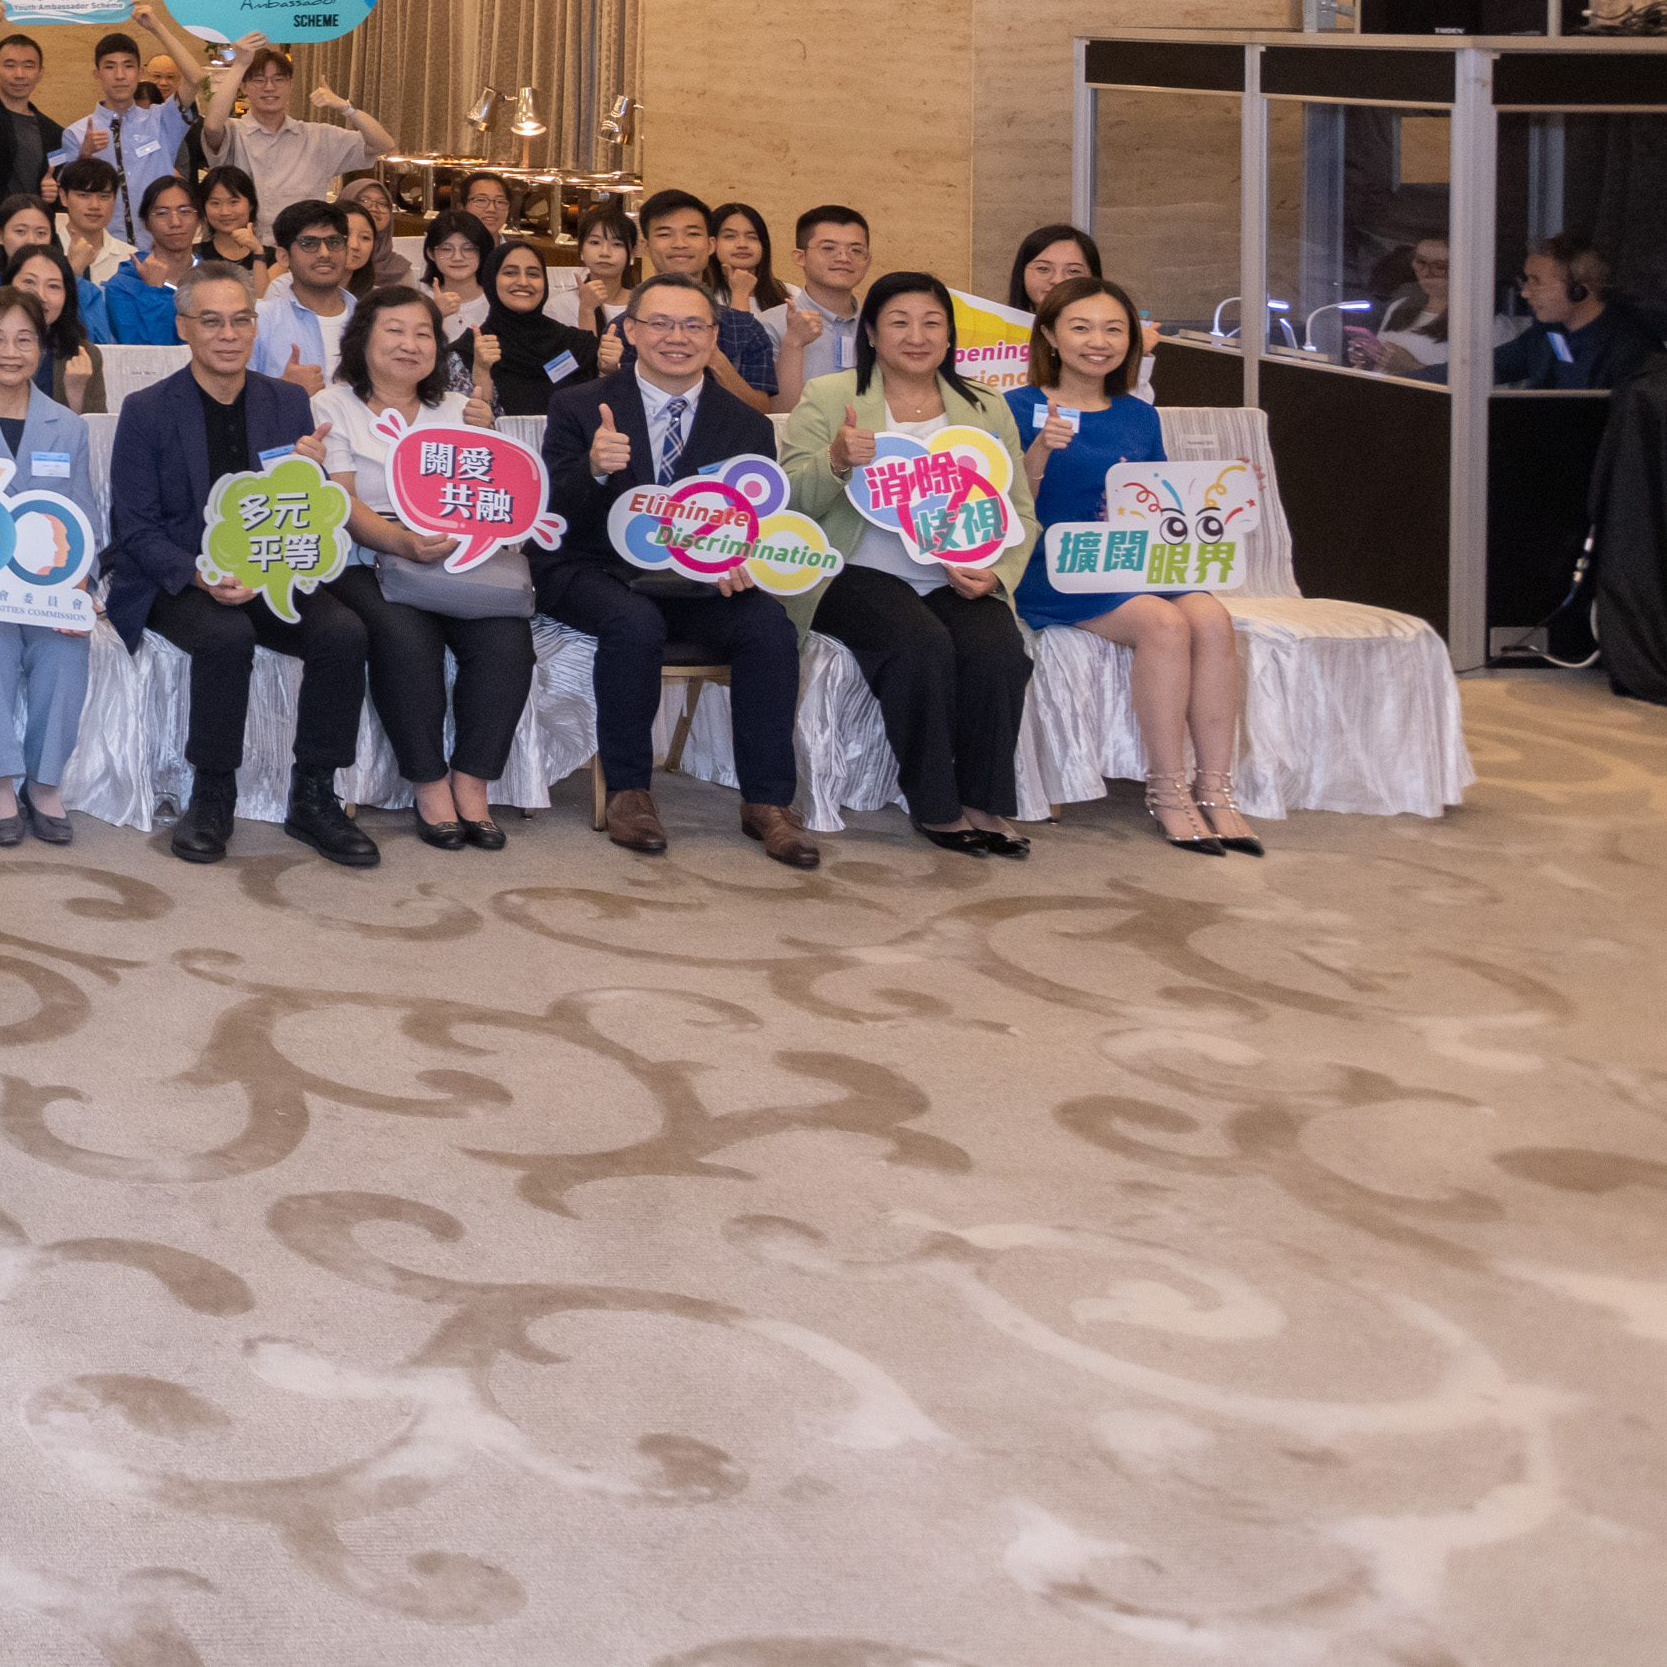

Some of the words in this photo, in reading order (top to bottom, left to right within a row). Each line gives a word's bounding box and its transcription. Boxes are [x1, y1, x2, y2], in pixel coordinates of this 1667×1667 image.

[13, 4, 37, 12] Youth
[38, 2, 89, 11] Ambassador
[91, 2, 124, 10] Scheme
[293, 14, 340, 28] SCHEME
[954, 340, 1031, 363] pening
[419, 440, 494, 484] 關愛
[864, 450, 964, 511] 消除
[238, 491, 312, 531] 多元
[439, 482, 515, 525] 共融
[628, 492, 751, 529] Eliminate
[914, 496, 1009, 556] 歧視
[247, 532, 320, 573] 平等
[654, 525, 838, 571] Discrimination
[27, 608, 87, 622] COMMISSION
